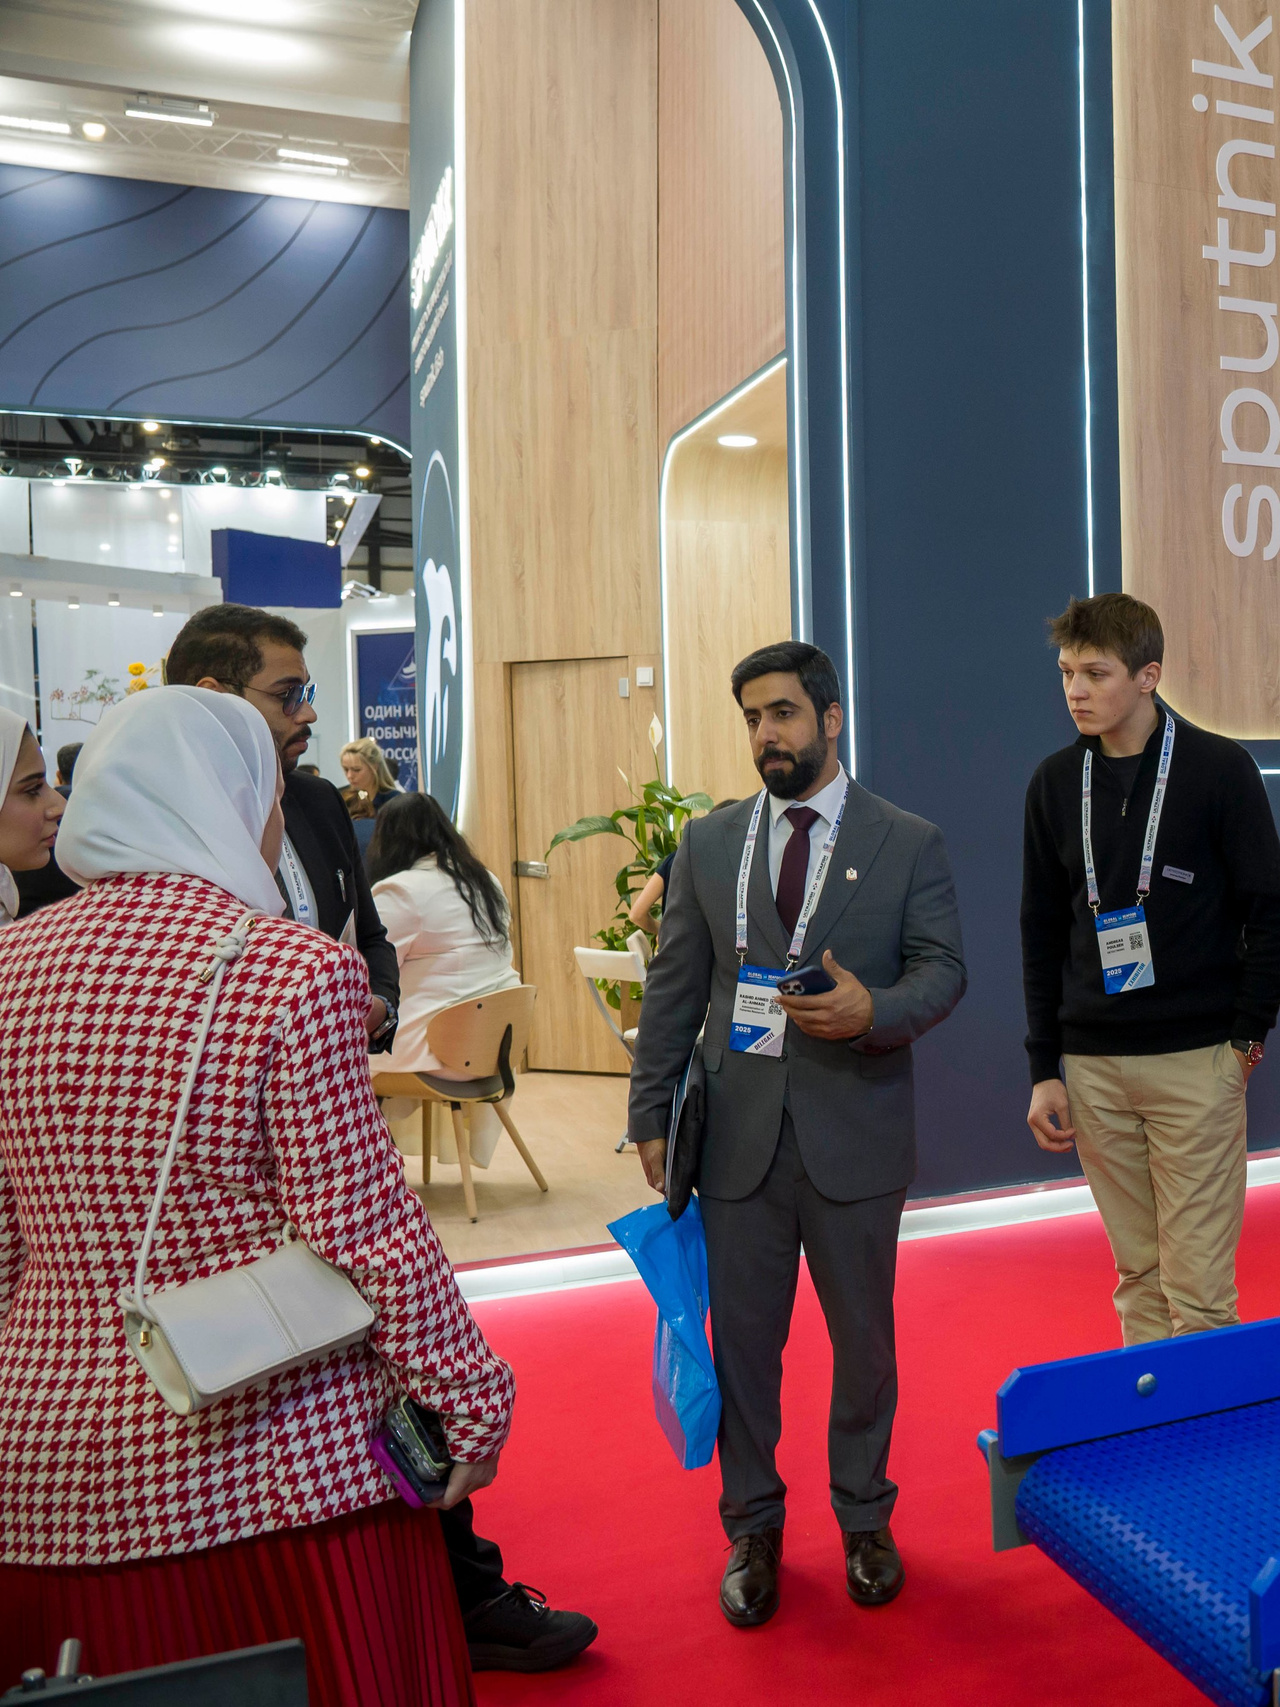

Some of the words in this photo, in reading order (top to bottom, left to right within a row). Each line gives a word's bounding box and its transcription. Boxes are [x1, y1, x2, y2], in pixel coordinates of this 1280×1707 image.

[364, 705, 402, 721] ОДИН
[1106, 968, 1122, 977] 2025
[1128, 962, 1146, 987] EXHIBITOR
[735, 1025, 751, 1033] 2025
[754, 1032, 775, 1051] DELEGATE
